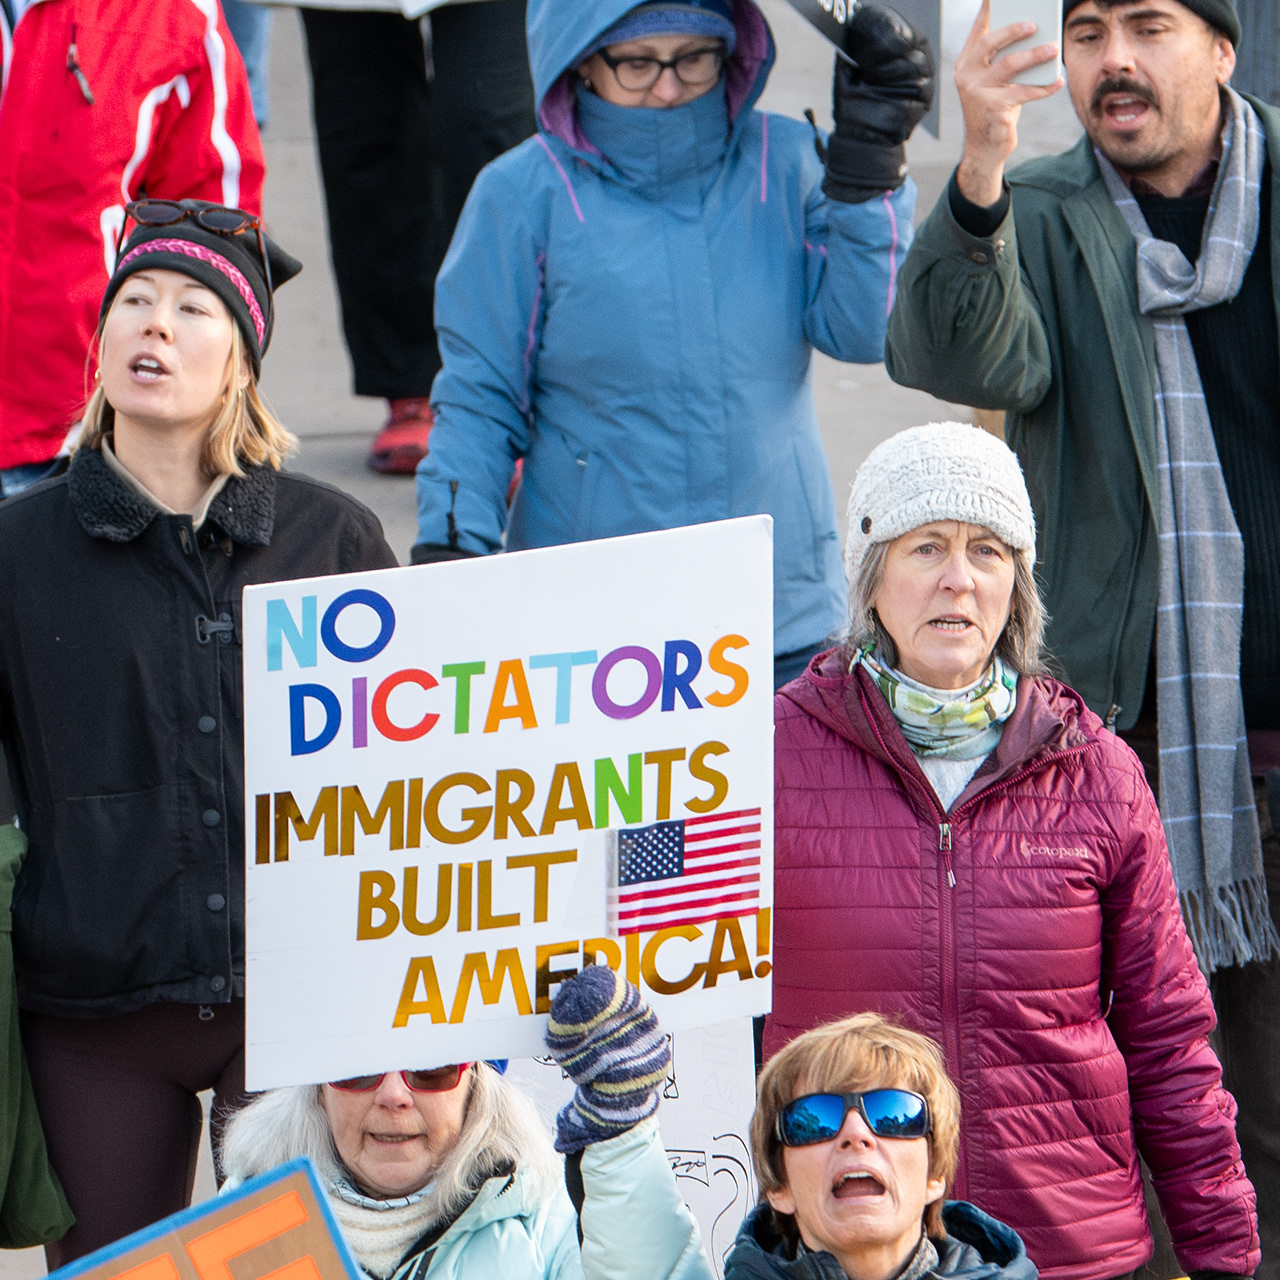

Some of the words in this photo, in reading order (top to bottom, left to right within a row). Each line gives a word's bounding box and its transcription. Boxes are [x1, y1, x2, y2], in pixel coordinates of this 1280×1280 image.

[266, 588, 396, 672] NO
[288, 634, 750, 756] DICTATORS
[255, 740, 731, 865] IMMIGRANTS
[357, 848, 578, 940] BUILT
[1030, 845, 1089, 859] cotopaxi
